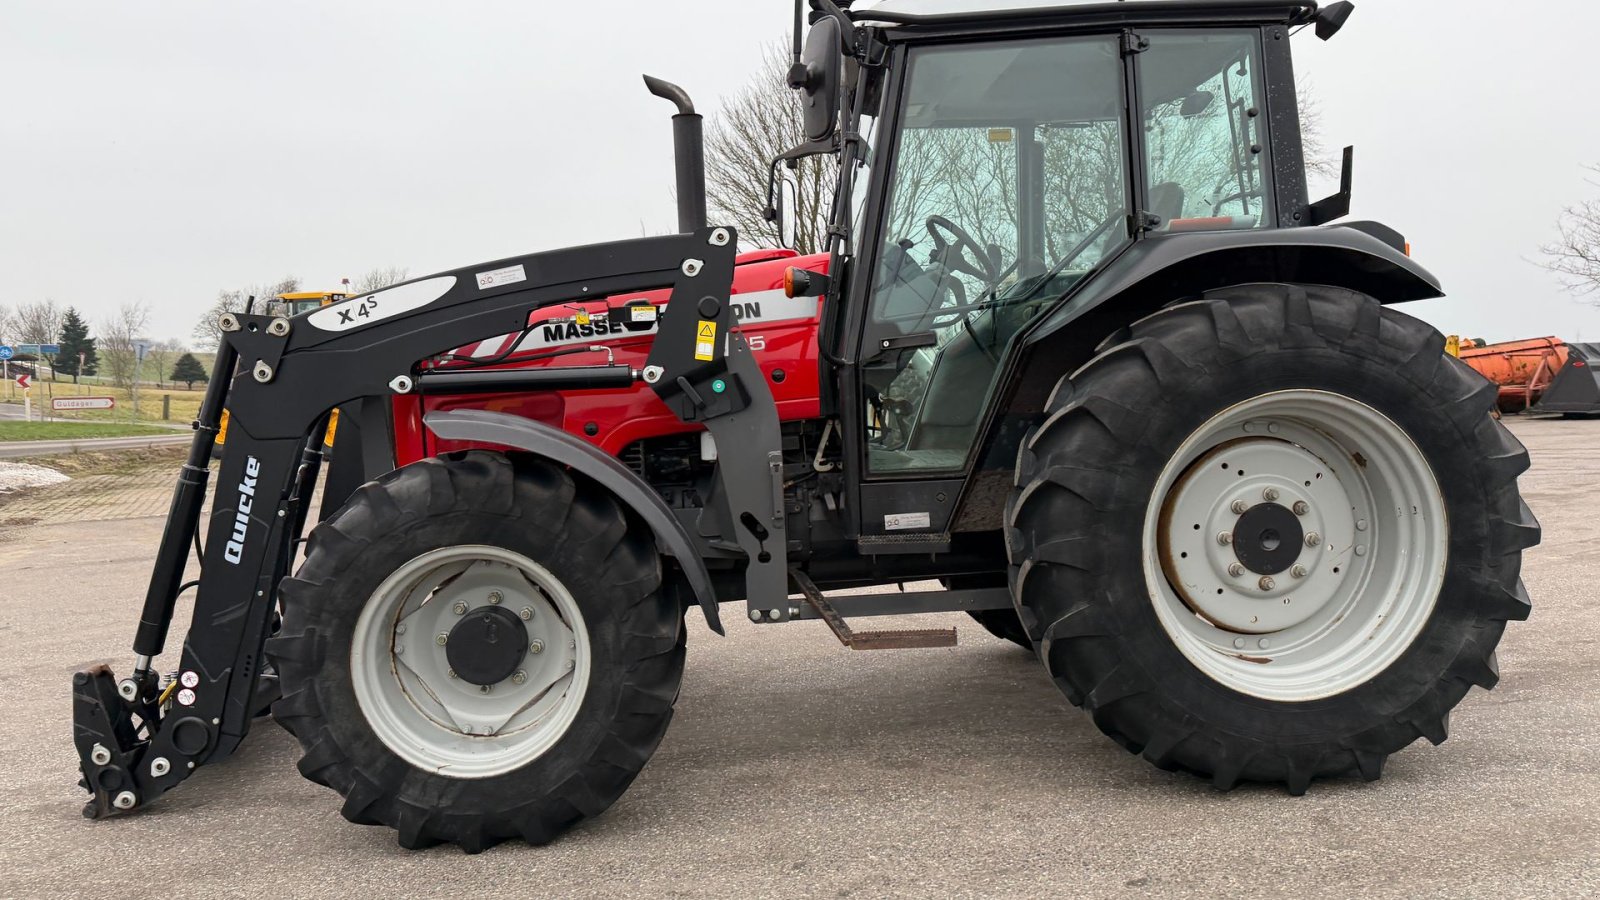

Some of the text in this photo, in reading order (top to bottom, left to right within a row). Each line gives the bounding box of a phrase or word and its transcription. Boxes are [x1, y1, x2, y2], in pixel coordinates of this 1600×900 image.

[337, 309, 354, 324] X
[543, 320, 623, 342] MASSE
[224, 456, 260, 565] Quicke
